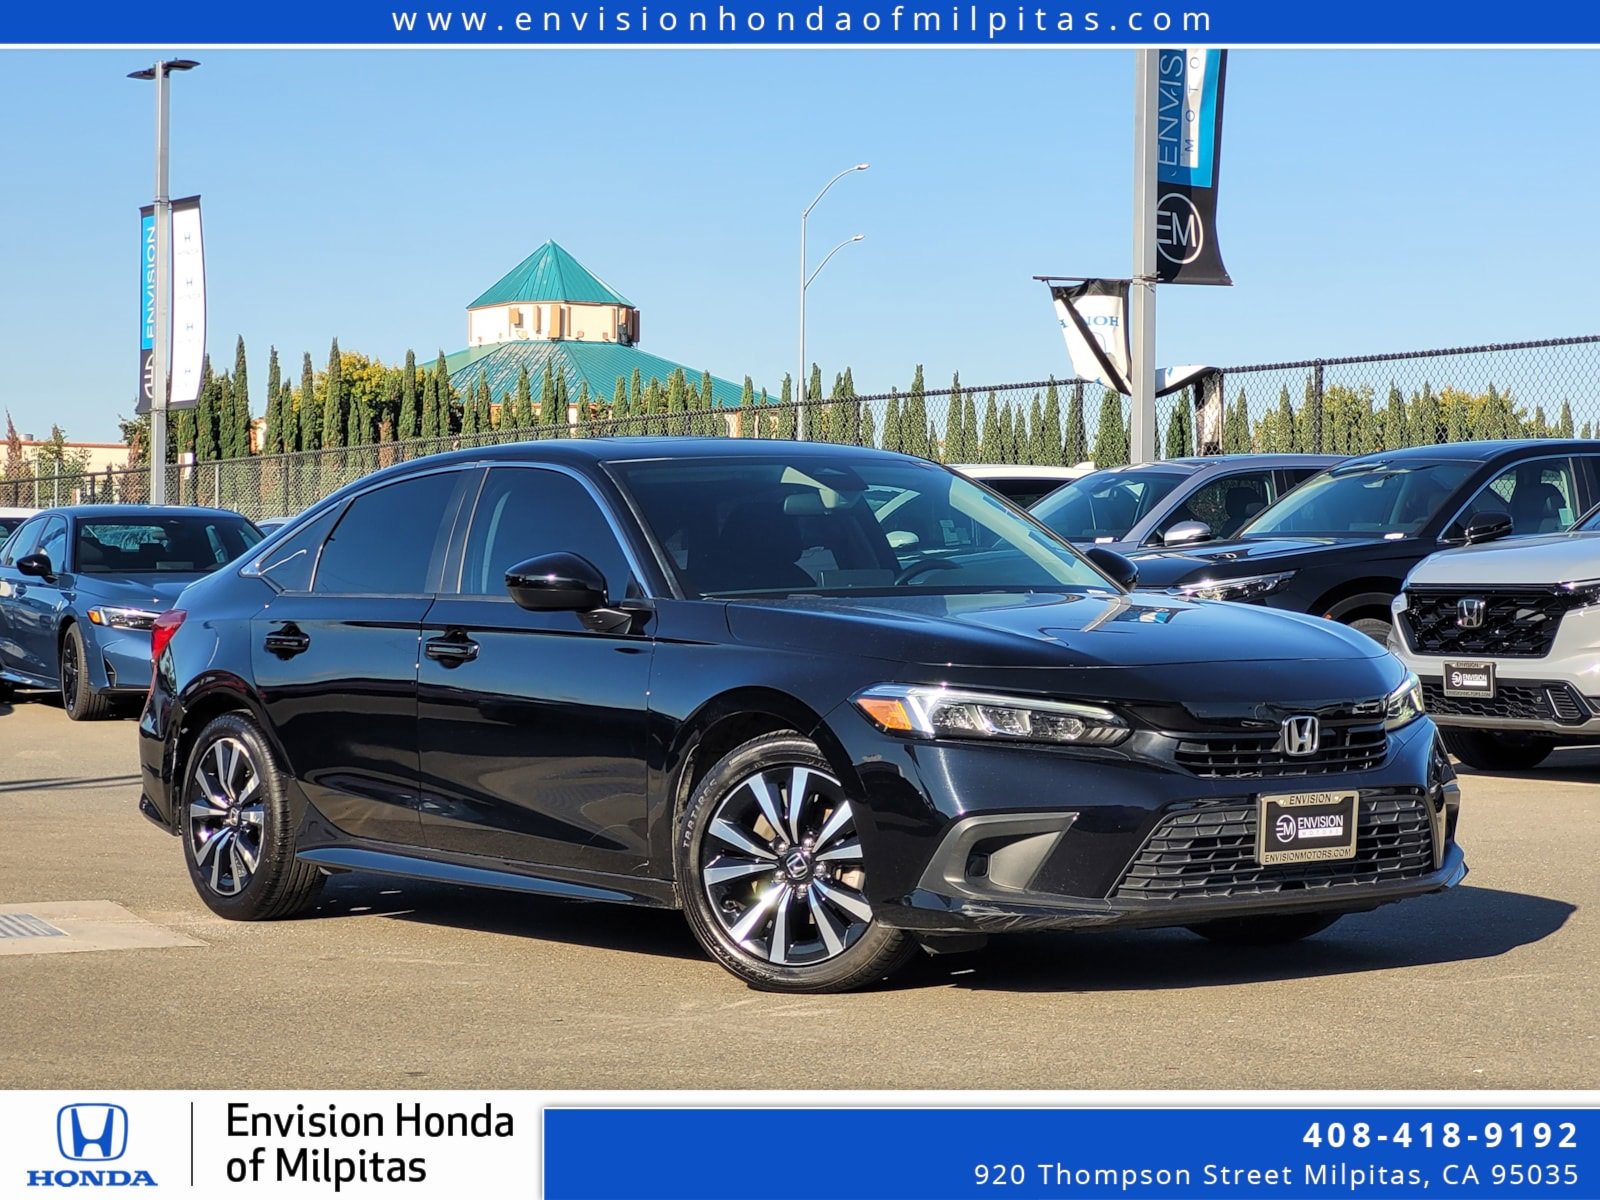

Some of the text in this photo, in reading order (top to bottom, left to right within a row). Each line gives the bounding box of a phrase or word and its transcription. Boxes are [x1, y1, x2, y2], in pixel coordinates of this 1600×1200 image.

[1289, 794, 1331, 805] ENVISION
[1298, 815, 1343, 829] ENVISION
[1265, 848, 1351, 863] ENVISIONMOTORS.COM
